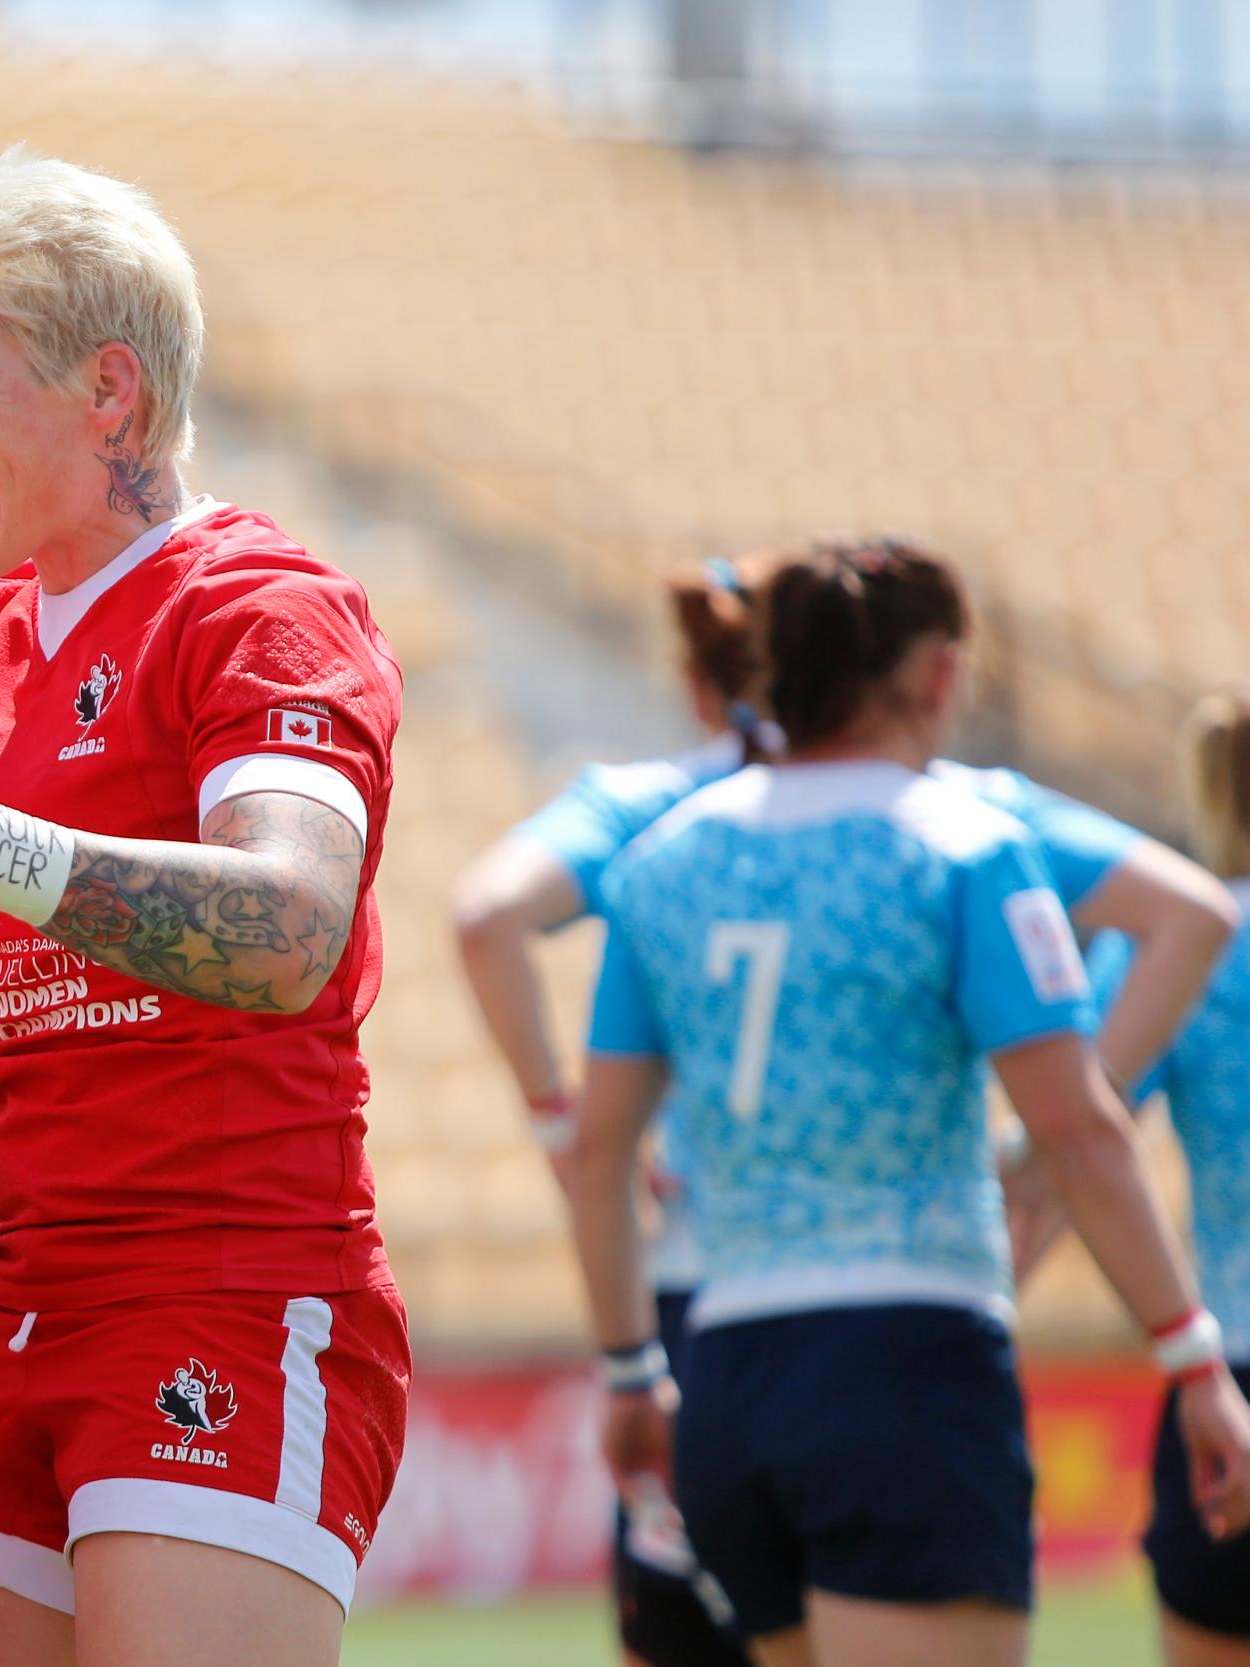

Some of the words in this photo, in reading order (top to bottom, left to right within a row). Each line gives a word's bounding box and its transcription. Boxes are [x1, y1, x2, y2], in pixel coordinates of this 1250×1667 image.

[58, 736, 105, 761] CANADA
[707, 920, 790, 1122] 7
[150, 1442, 228, 1469] CANADA
